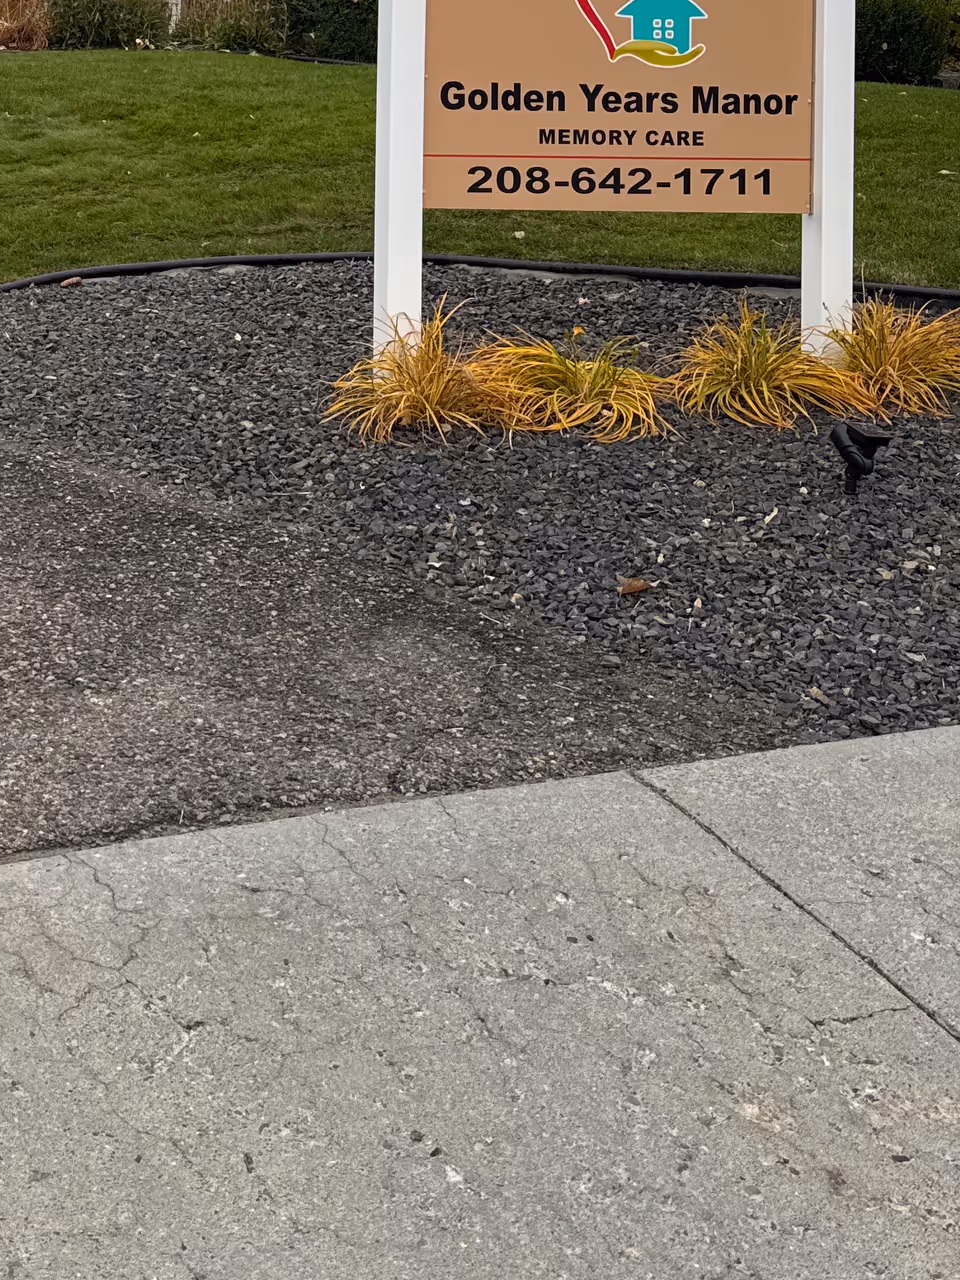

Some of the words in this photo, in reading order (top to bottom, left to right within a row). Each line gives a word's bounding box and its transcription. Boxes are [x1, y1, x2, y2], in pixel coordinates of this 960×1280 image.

[440, 80, 566, 112] Golden
[578, 83, 679, 114] Years
[692, 85, 799, 116] Manor
[539, 128, 638, 146] MEMORY
[645, 129, 705, 147] CARE
[466, 165, 771, 196] 208-642-1711
